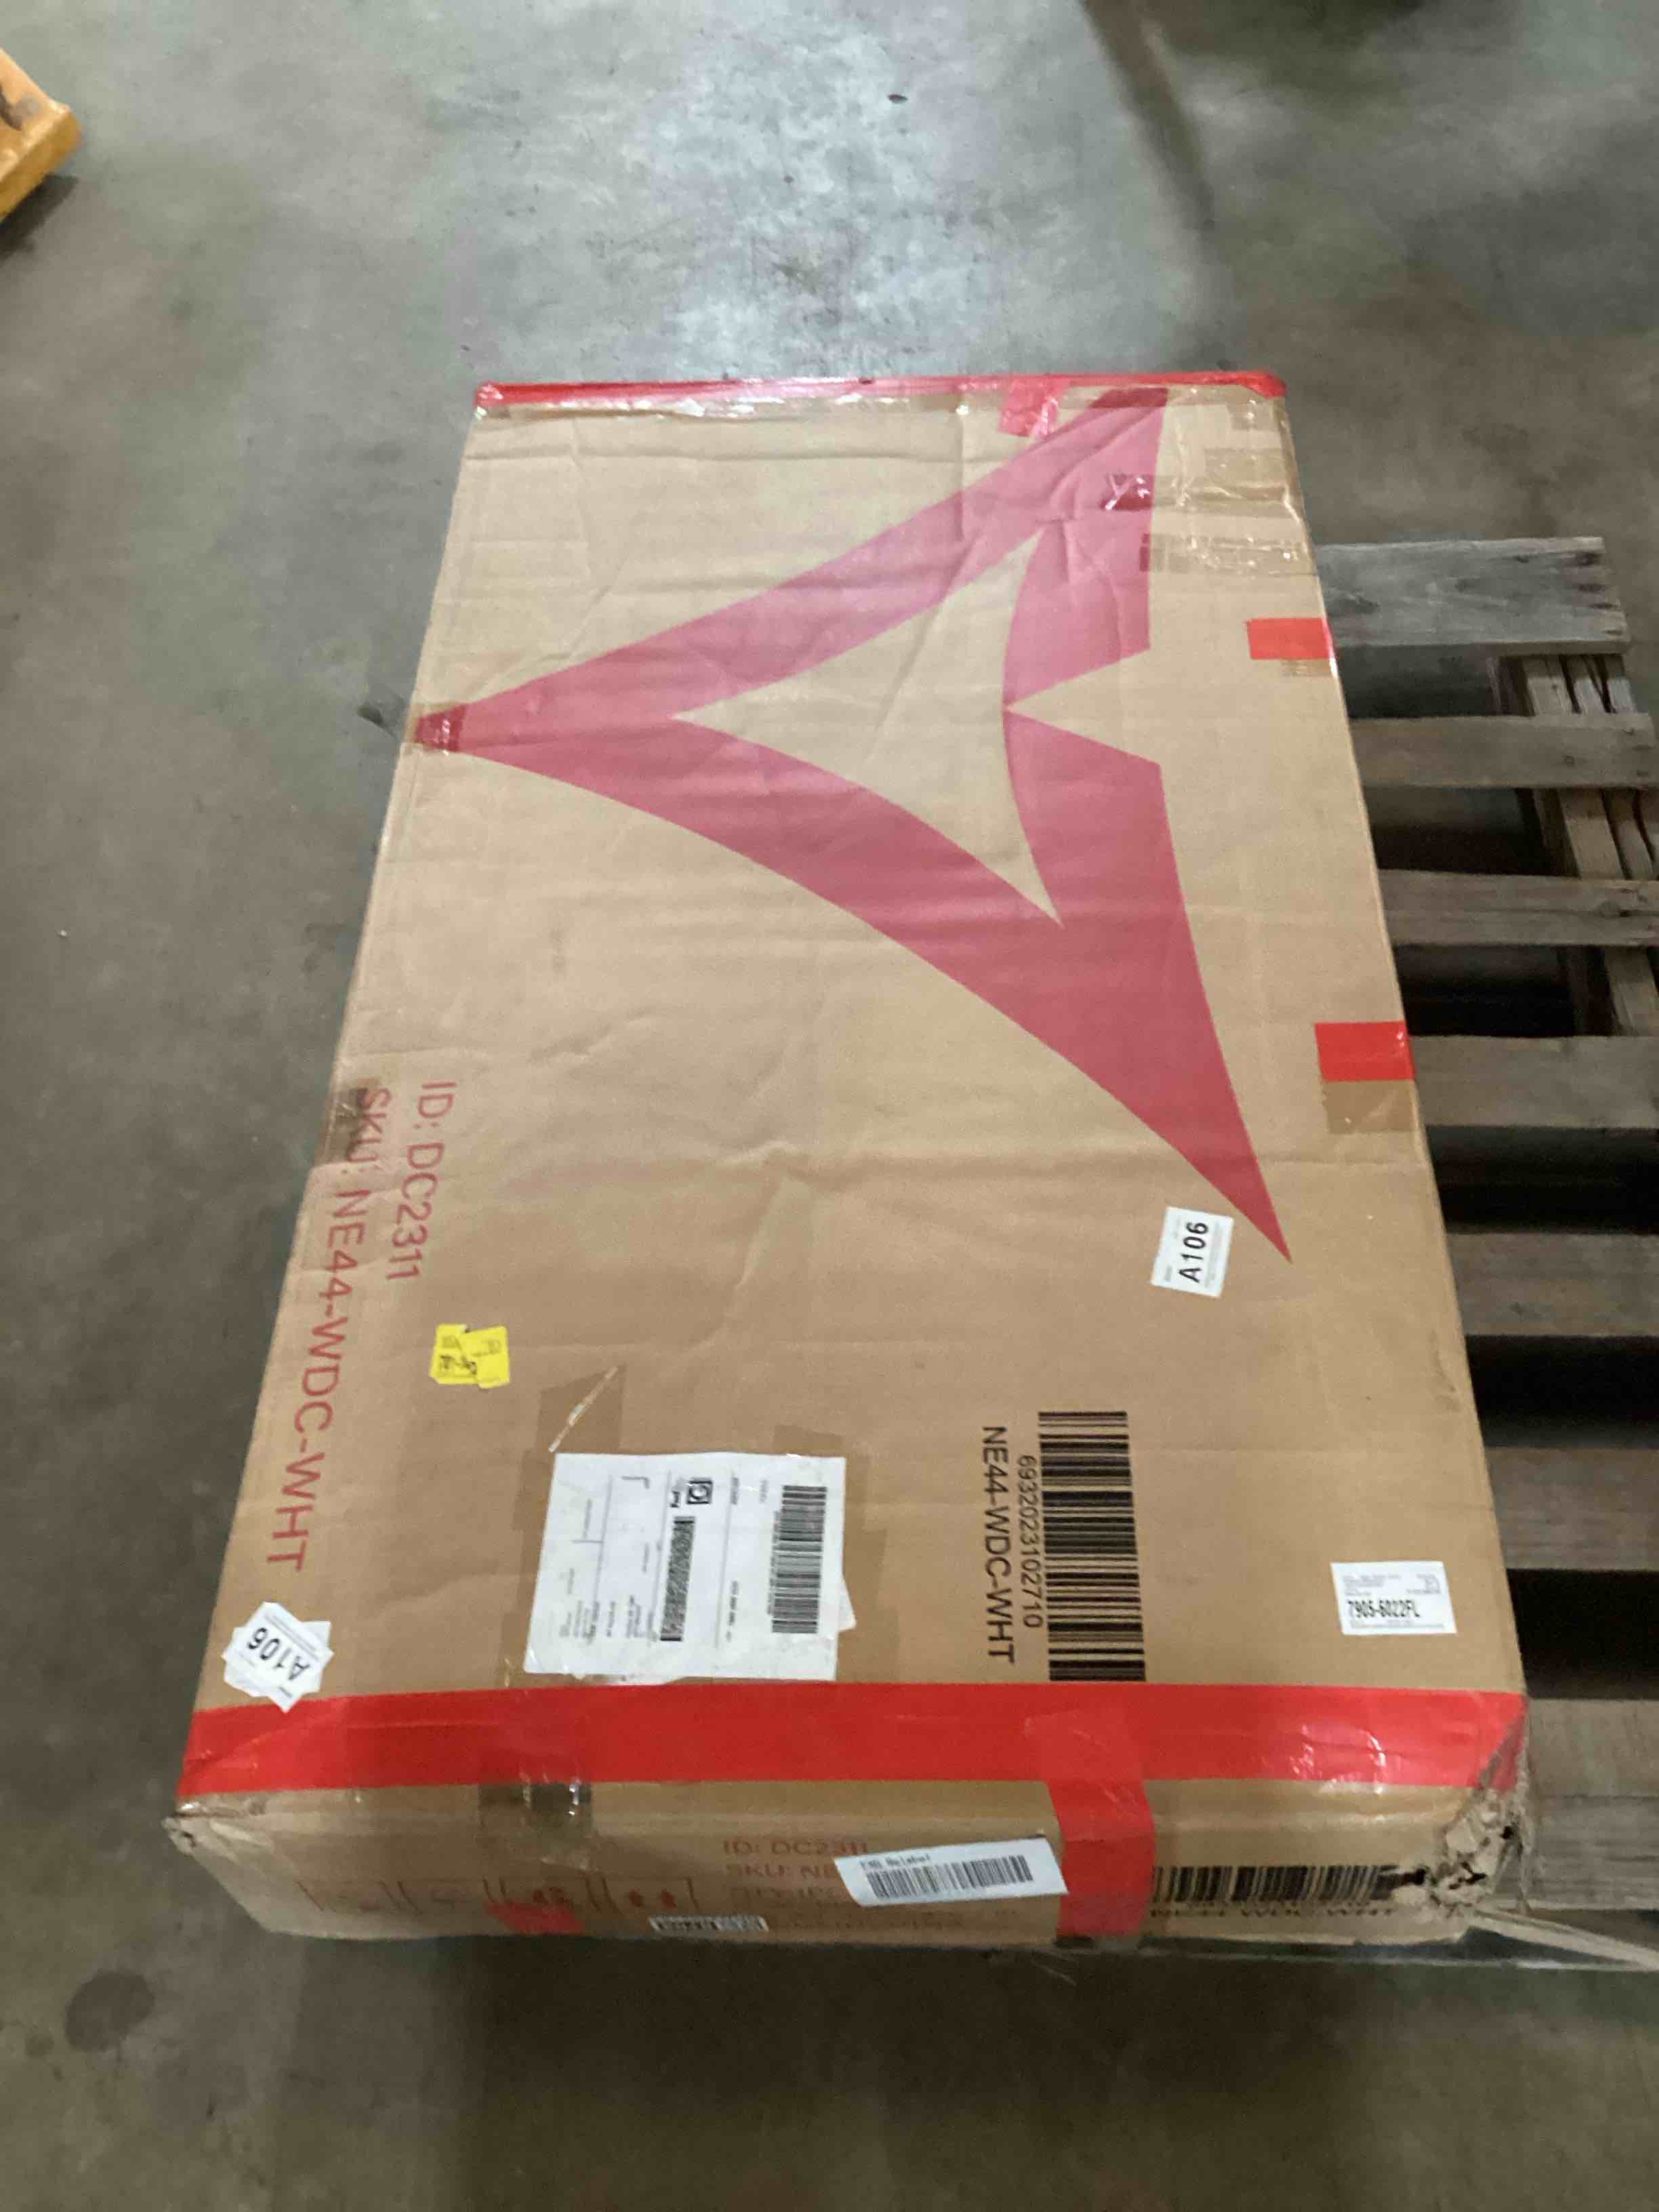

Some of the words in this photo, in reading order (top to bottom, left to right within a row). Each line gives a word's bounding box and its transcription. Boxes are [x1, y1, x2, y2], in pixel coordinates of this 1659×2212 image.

[340, 1087, 392, 1175] SKU:
[415, 1082, 457, 1129] ID:
[386, 1140, 445, 1280] DC2311
[1177, 1222, 1209, 1284] A106
[266, 1189, 371, 1572] NE44-WDC-WHT
[982, 1425, 1015, 1665] NE44-WDC-WHT
[1017, 1454, 1044, 1629] 6932023102710
[246, 1628, 311, 1681] A106
